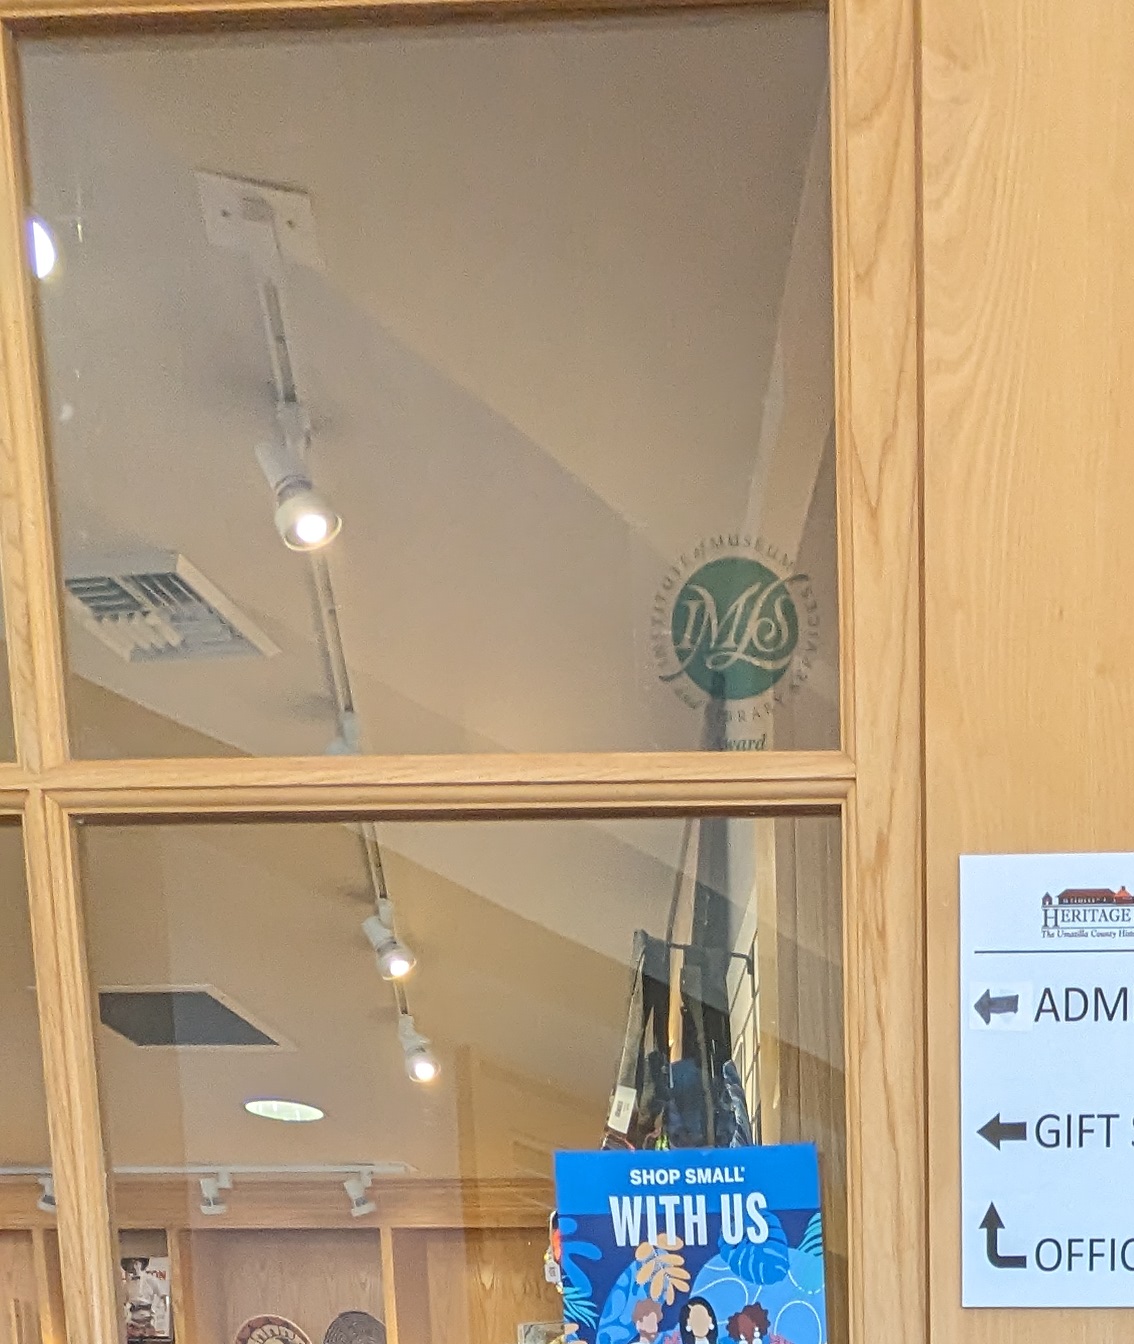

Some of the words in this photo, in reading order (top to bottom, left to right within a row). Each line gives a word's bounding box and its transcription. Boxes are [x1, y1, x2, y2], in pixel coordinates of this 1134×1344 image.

[1041, 907, 1131, 928] HERITAGE
[1041, 930, 1055, 938] The
[1091, 929, 1117, 940] County
[1034, 1113, 1120, 1149] GIFT
[629, 1168, 681, 1186] SHOP
[685, 1166, 745, 1184] SMALL
[608, 1195, 709, 1247] WITH
[720, 1191, 769, 1246] US
